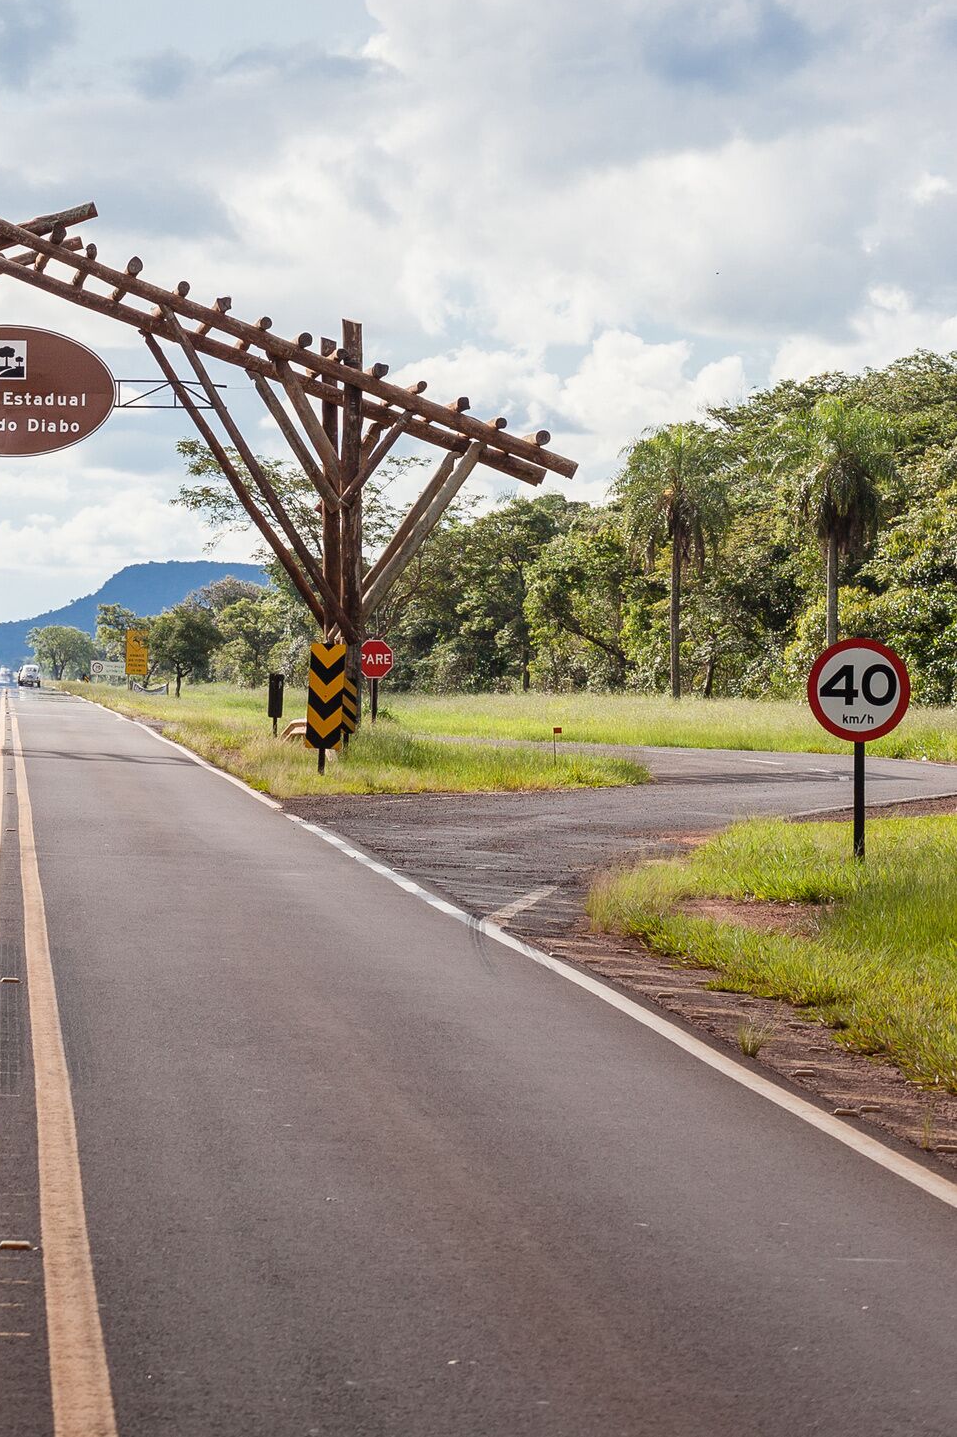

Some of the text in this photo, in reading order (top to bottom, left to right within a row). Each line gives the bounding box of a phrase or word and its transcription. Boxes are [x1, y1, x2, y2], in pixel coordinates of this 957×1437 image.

[3, 391, 86, 407] Estadual
[27, 418, 80, 433] Diabo
[819, 663, 897, 707] 40
[842, 713, 874, 725] km/h
